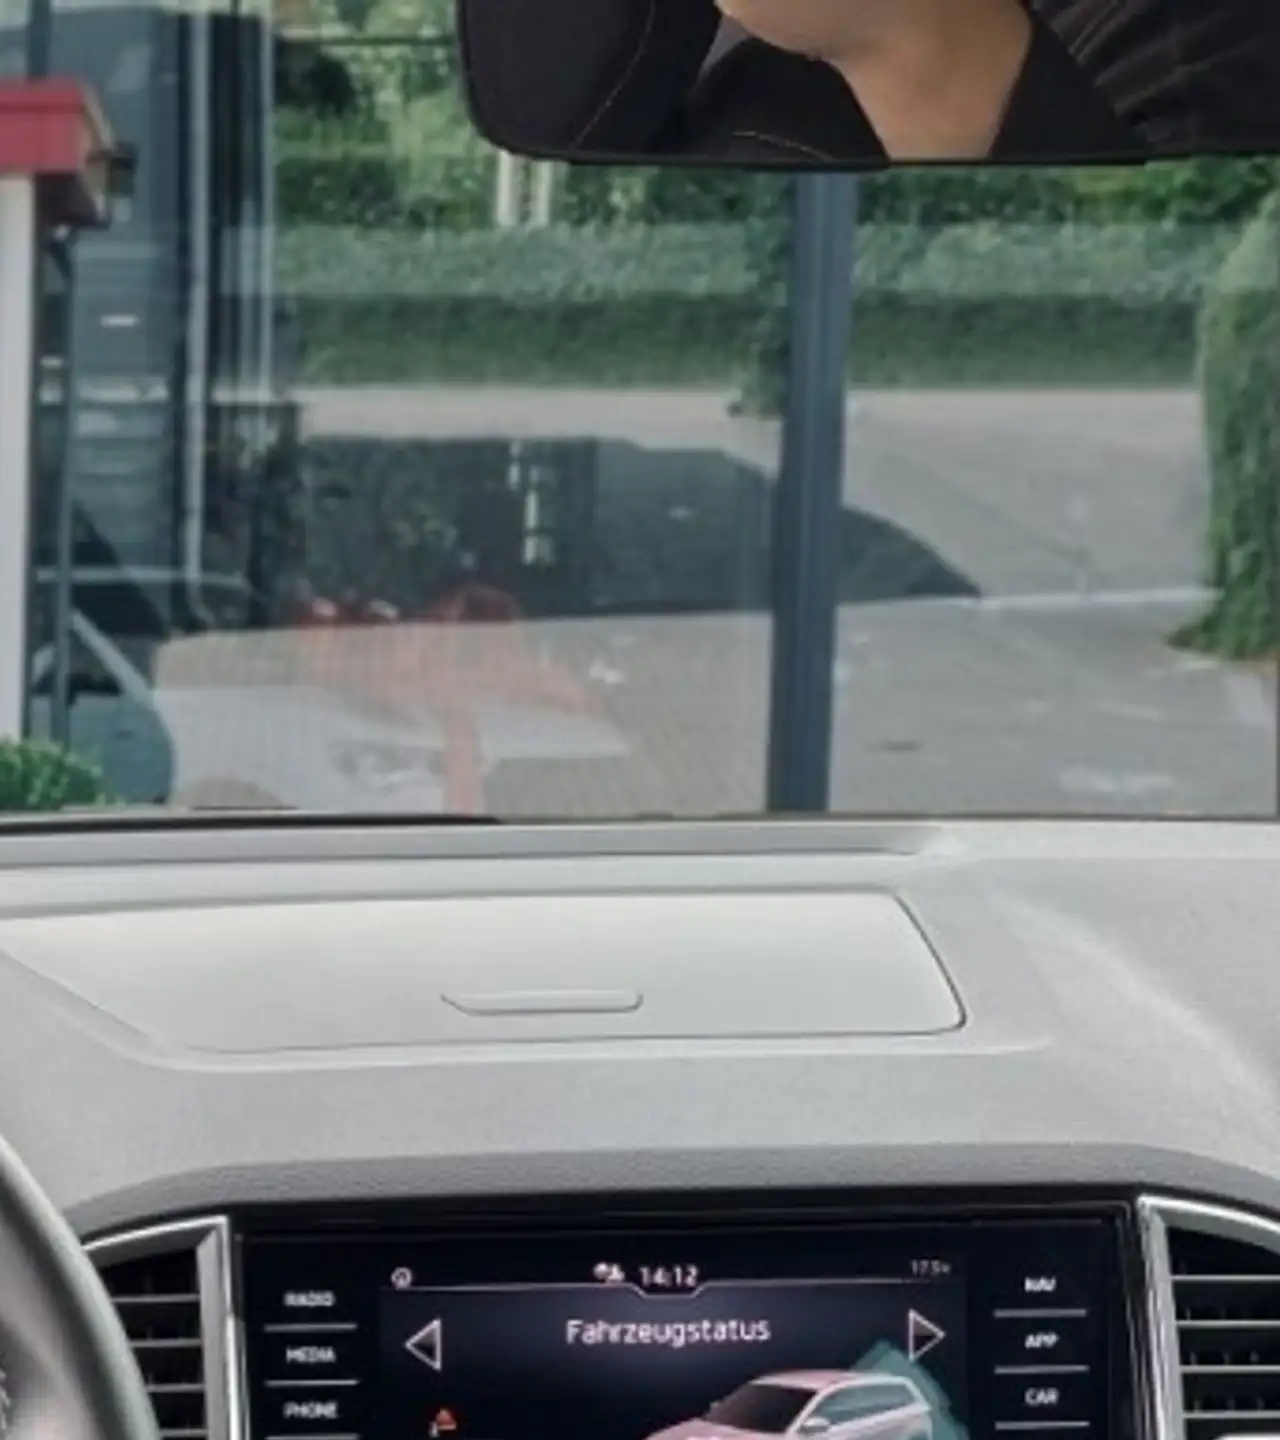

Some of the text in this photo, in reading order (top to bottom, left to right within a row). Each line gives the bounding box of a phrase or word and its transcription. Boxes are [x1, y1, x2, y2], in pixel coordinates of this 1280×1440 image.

[640, 1266, 700, 1288] 14:12
[1024, 1276, 1057, 1292] NAV
[283, 1291, 336, 1307] RADIO
[566, 1319, 771, 1348] Fahrzeugstatus
[1024, 1332, 1059, 1349] APP
[285, 1345, 337, 1363] MEDIA
[1024, 1387, 1060, 1406] CAR
[283, 1401, 339, 1419] PHONE
